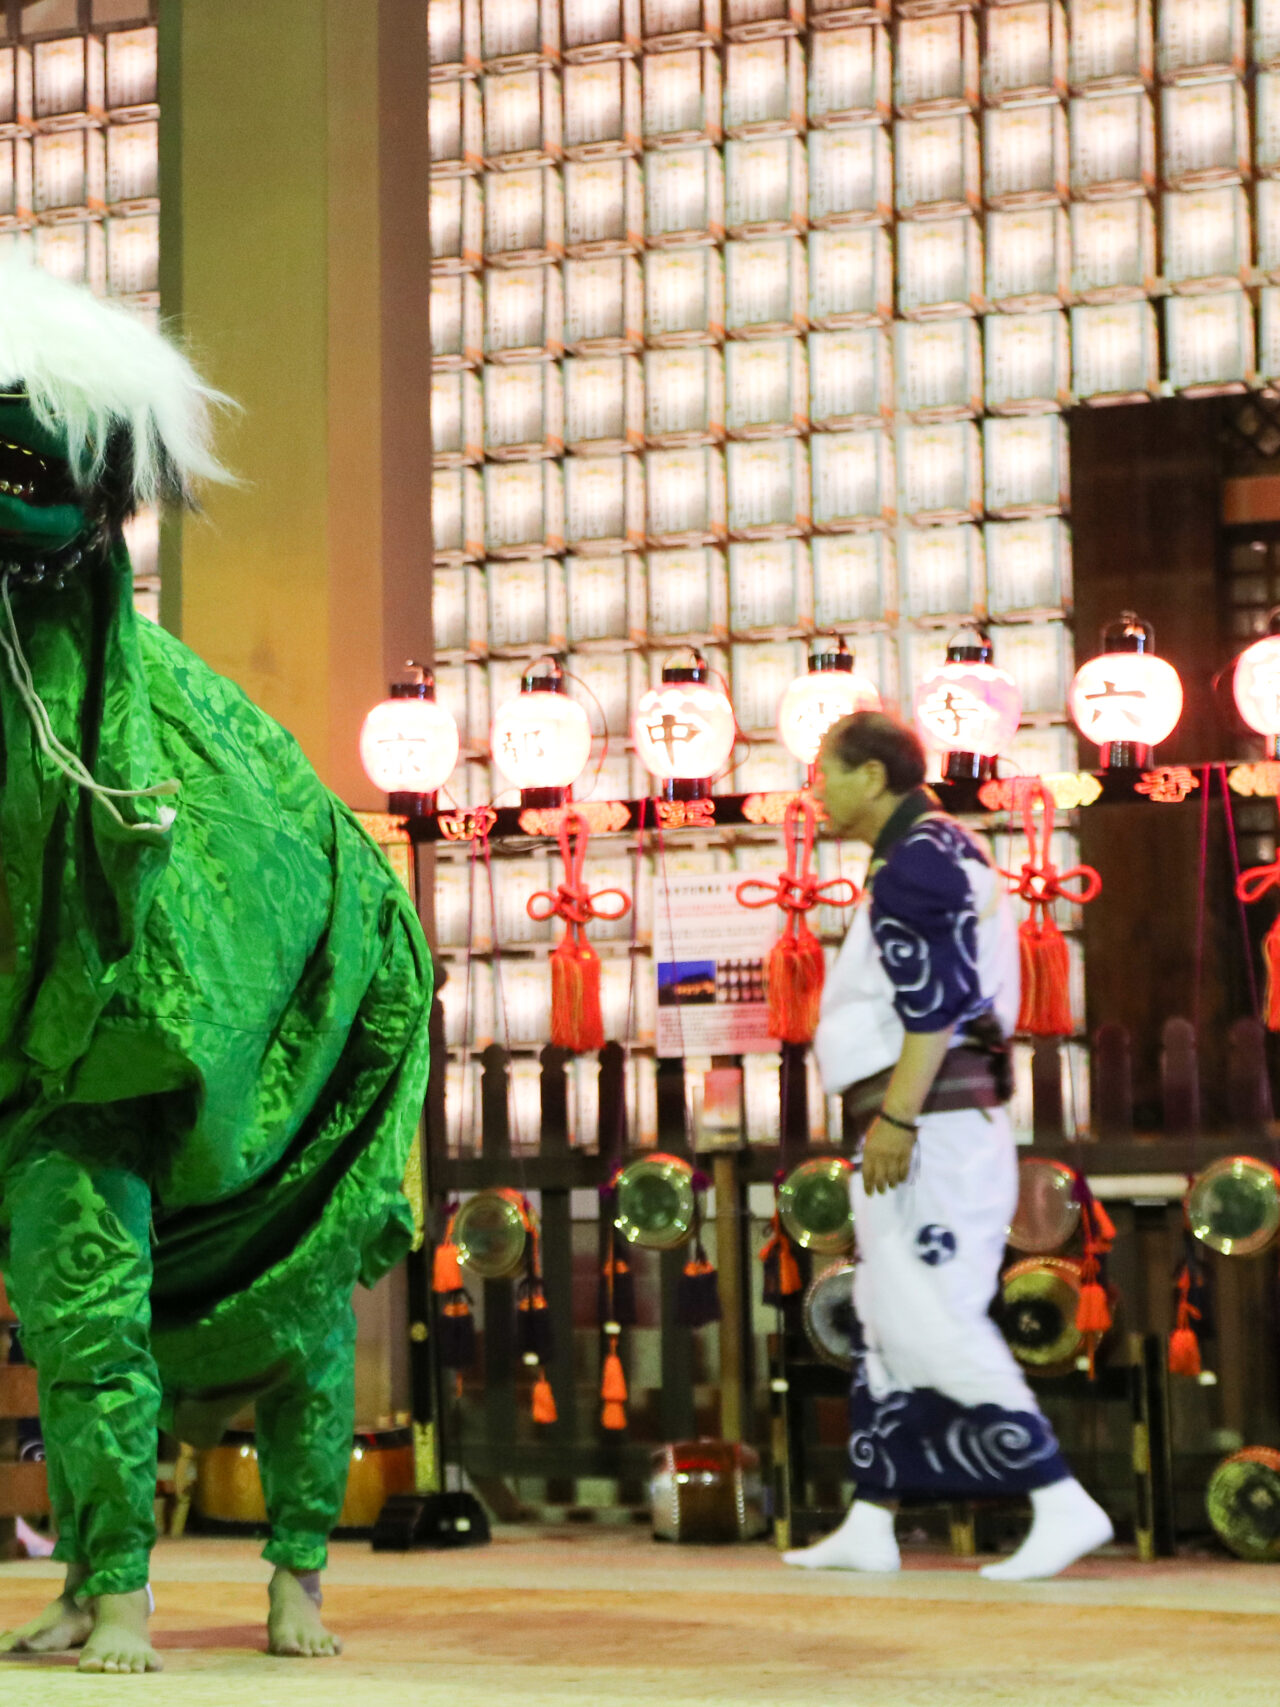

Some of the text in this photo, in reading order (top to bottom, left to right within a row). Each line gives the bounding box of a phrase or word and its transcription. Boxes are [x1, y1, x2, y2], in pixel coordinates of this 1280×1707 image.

[927, 692, 980, 737] 寺
[1085, 681, 1147, 728] 六
[647, 714, 702, 766] 中
